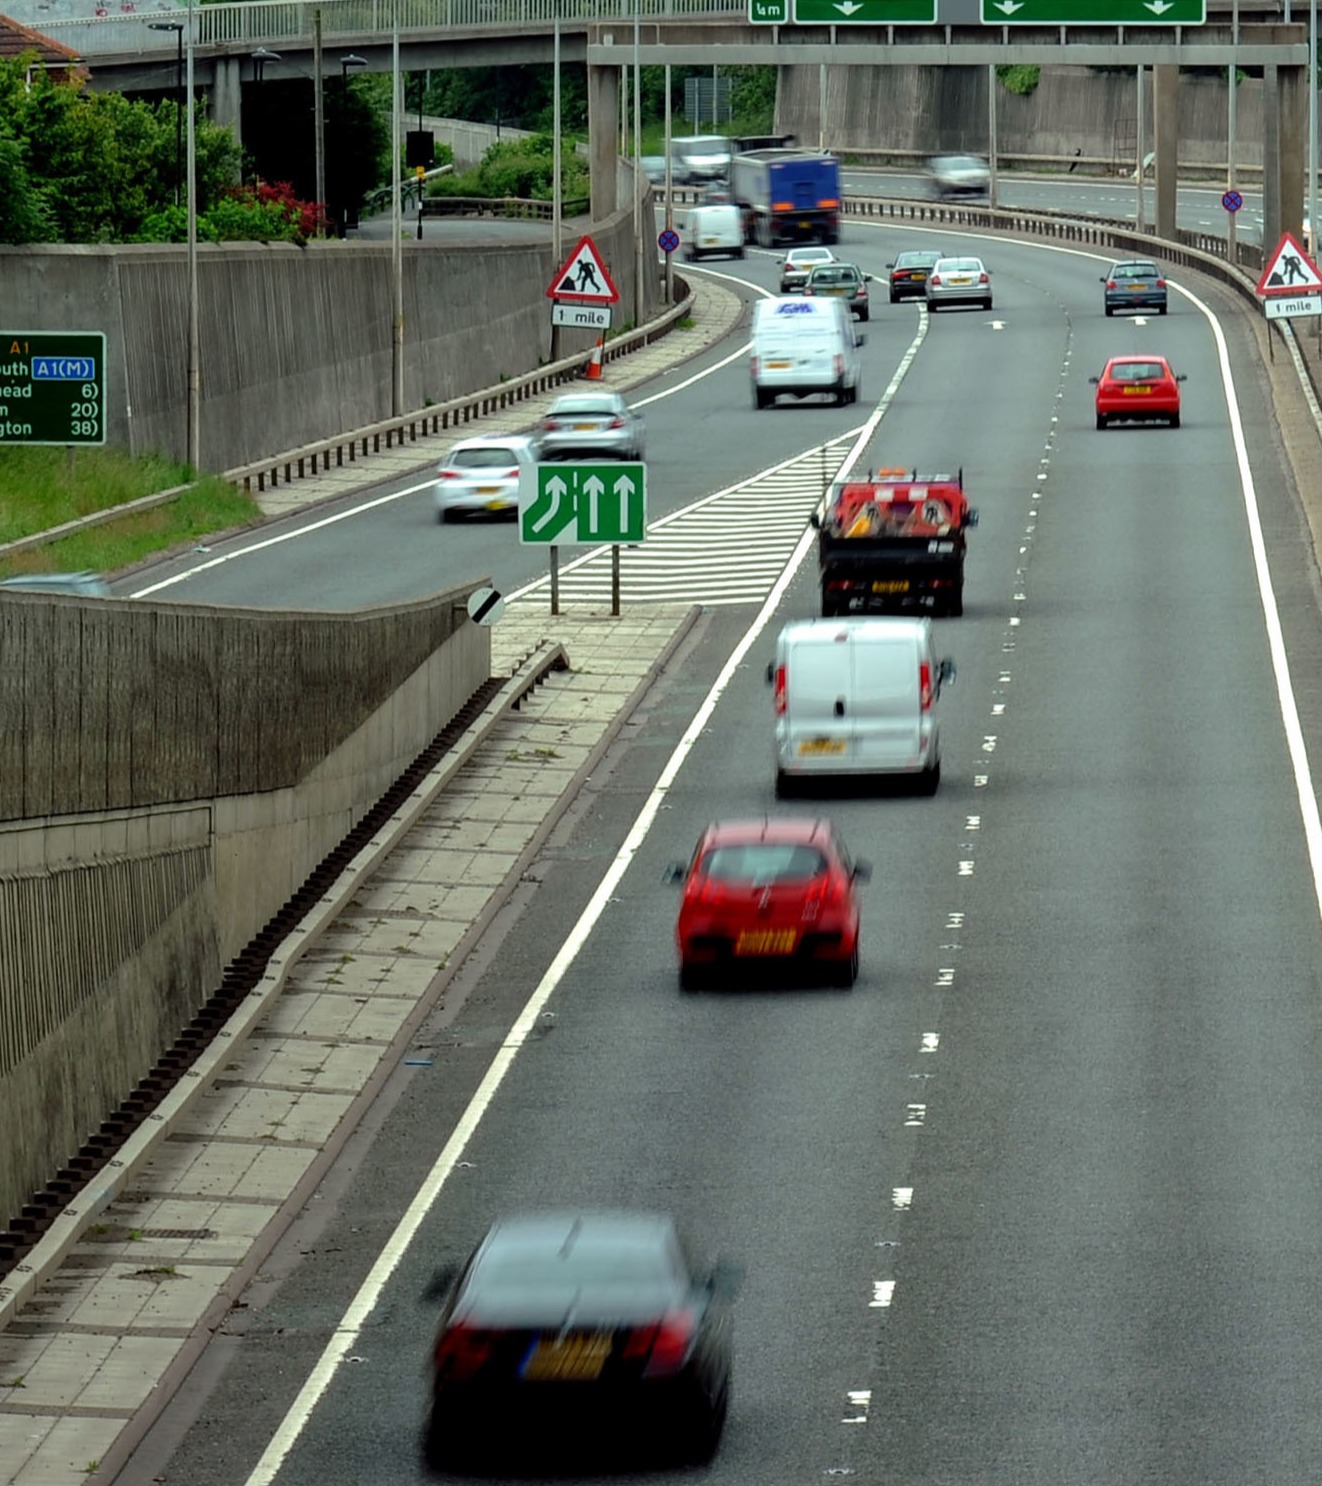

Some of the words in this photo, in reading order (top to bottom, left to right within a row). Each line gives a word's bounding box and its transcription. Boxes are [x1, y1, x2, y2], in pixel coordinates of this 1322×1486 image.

[767, 5, 780, 16] m
[1285, 300, 1312, 313] mile
[575, 311, 605, 325] mile
[10, 341, 29, 354] A1
[0, 361, 29, 376] uth
[37, 359, 90, 378] A1(M)
[0, 383, 32, 398] ead
[81, 382, 99, 400] 6)
[70, 401, 99, 418] 20)
[70, 419, 99, 437] 38)
